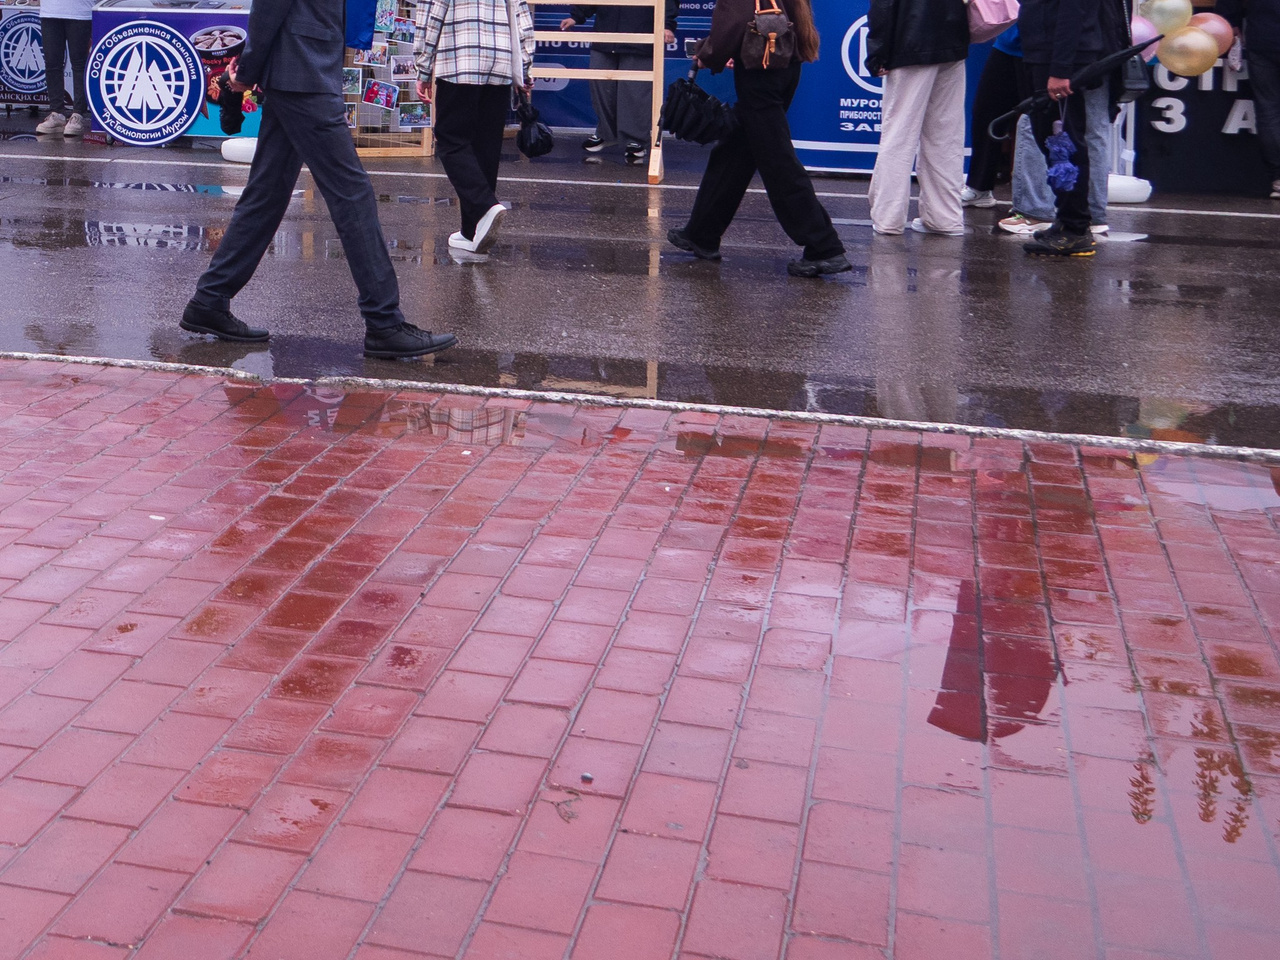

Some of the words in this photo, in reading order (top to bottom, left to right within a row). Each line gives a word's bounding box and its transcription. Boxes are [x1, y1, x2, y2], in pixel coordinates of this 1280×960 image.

[91, 52, 104, 79] ООО
[171, 38, 197, 80] компания
[33, 94, 50, 102] СЛИ
